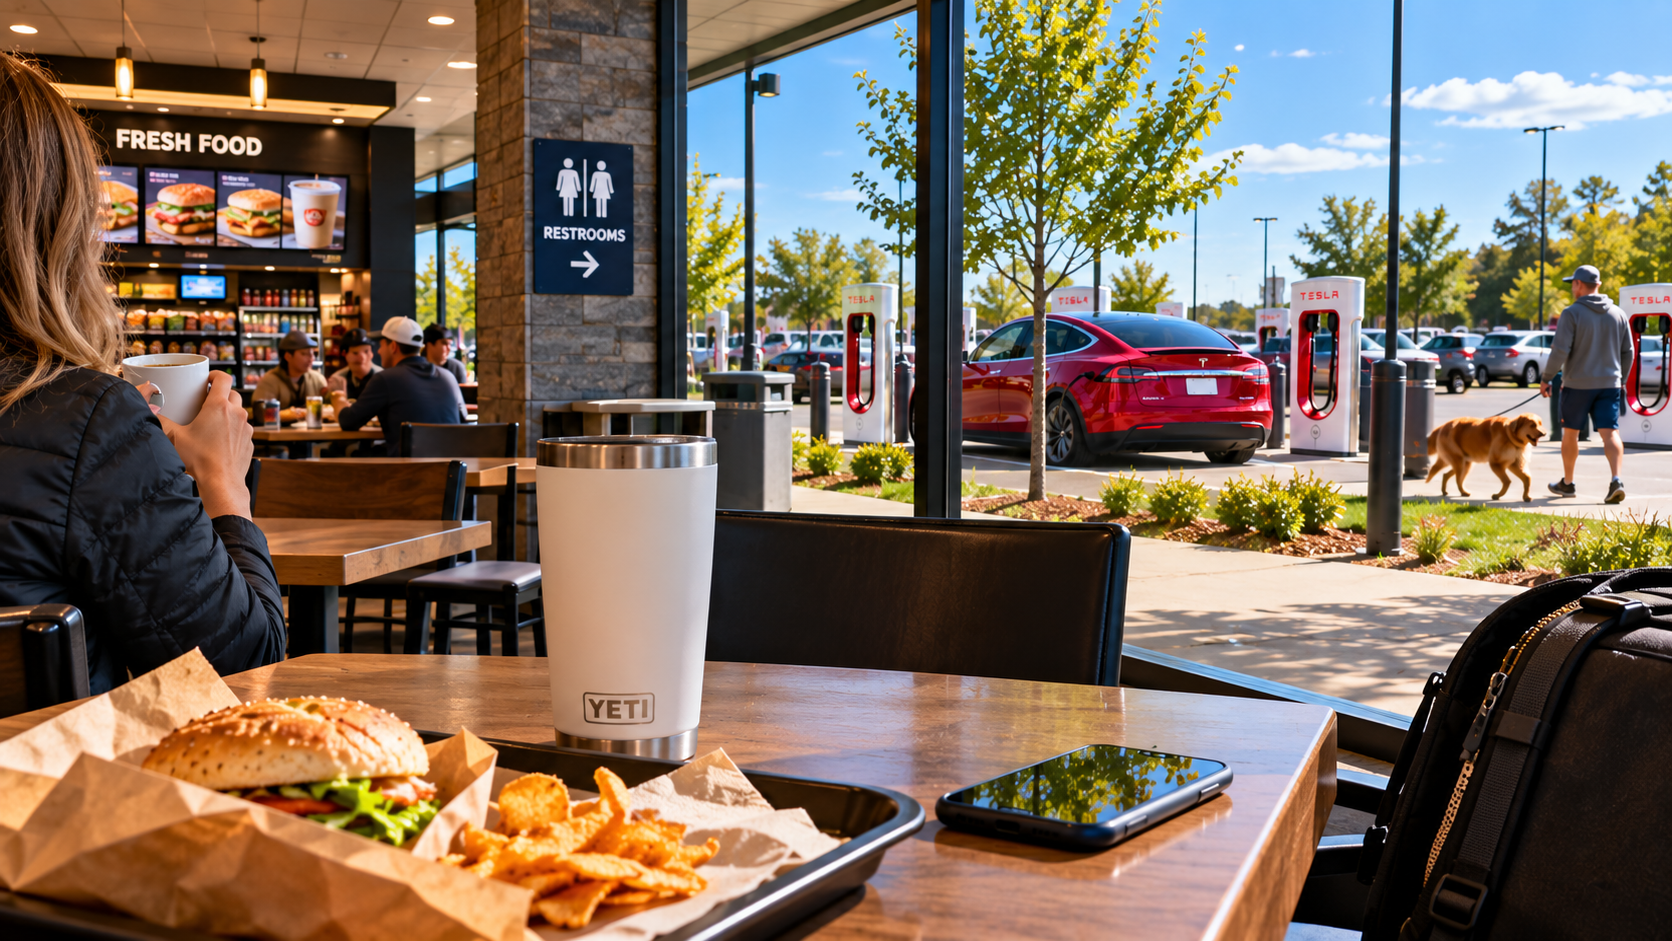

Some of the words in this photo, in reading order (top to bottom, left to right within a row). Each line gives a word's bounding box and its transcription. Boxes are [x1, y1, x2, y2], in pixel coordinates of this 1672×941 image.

[116, 128, 191, 152] FRESH
[198, 133, 263, 156] FOOD
[543, 225, 626, 242] RESTROOMS
[1300, 290, 1339, 300] TESLA
[1630, 295, 1671, 305] TESLA
[588, 698, 648, 719] YETI
